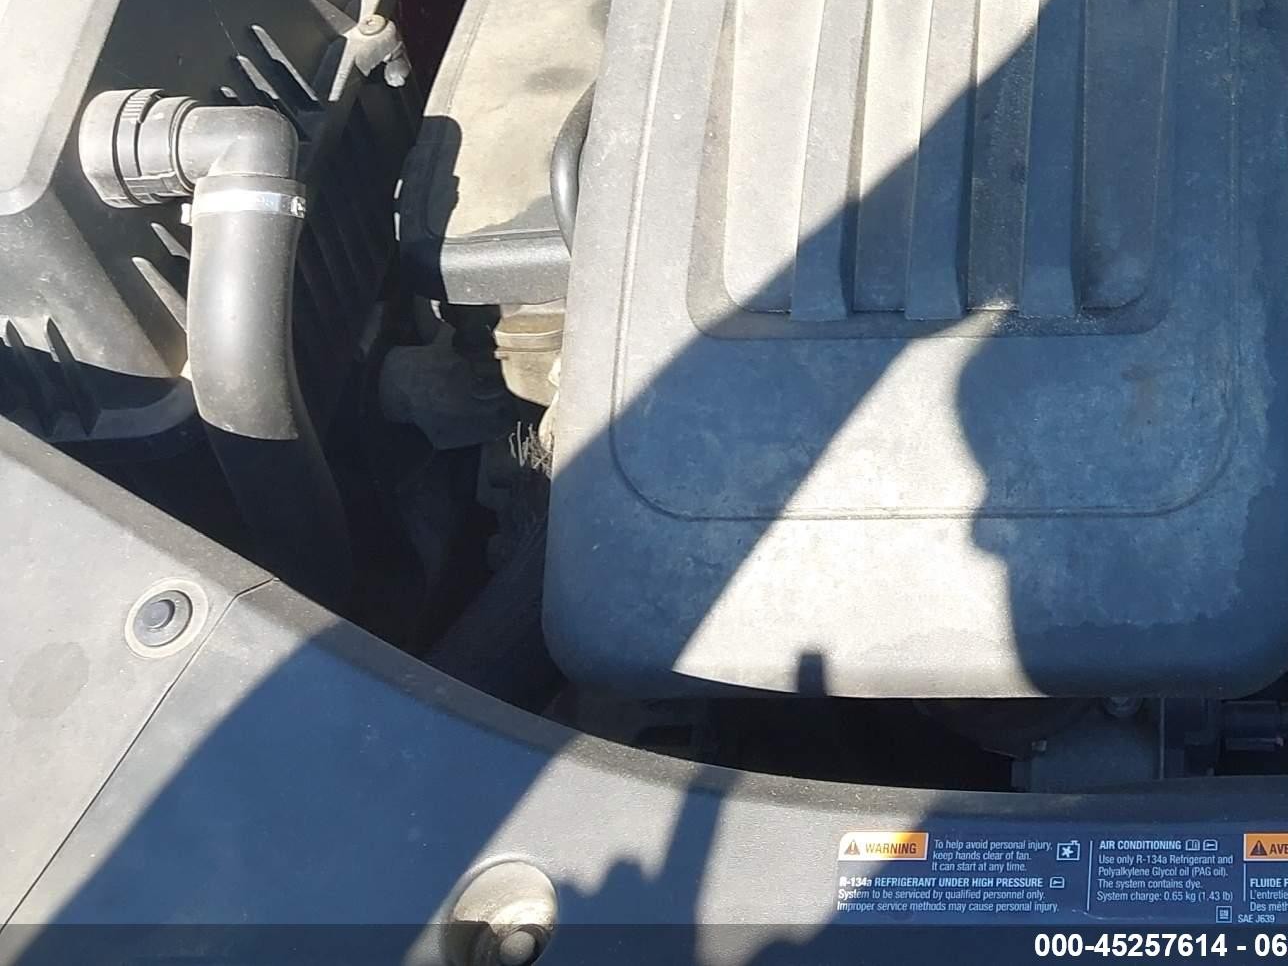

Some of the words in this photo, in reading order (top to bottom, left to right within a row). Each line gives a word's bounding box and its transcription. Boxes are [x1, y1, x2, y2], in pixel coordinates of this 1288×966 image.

[865, 843, 917, 854] WARNING
[933, 840, 943, 849] To
[945, 840, 963, 850] help
[965, 840, 988, 849] avoid
[990, 840, 1026, 850] personal
[1100, 840, 1115, 850] AIR
[1117, 840, 1181, 850] CONDITIONING
[932, 851, 953, 861] keep
[954, 851, 981, 860] hands
[982, 851, 1003, 860] clear
[1005, 851, 1015, 860] of
[1016, 851, 1032, 860] fan.
[1098, 854, 1114, 864] Use
[1116, 854, 1134, 865] only
[1136, 854, 1167, 864] R-134a
[1169, 854, 1215, 866] Refrigerant
[1217, 854, 1233, 864] and
[931, 862, 938, 871] It
[956, 862, 977, 871] start
[978, 862, 987, 871] at
[988, 864, 1004, 873] any
[1006, 862, 1027, 871] time.
[1098, 866, 1150, 878] Polyalkylene
[1151, 866, 1178, 878] Glycol
[1180, 866, 1189, 876] oil
[1191, 866, 1211, 877] (PAG
[1213, 866, 1229, 877] oil).
[839, 876, 872, 887] R-134a
[874, 876, 936, 887] REFRIGERANT
[939, 876, 970, 887] UNDER
[971, 876, 993, 887] HIGH
[995, 876, 1044, 887] PRESSURE
[1097, 878, 1113, 888] The
[1115, 878, 1145, 890] system
[1147, 878, 1183, 888] contains
[1185, 878, 1203, 890] dye.
[1250, 877, 1281, 887] FLUIDE
[838, 889, 870, 901] System
[872, 890, 880, 899] to
[882, 890, 893, 899] be
[895, 890, 930, 899] serviced
[932, 890, 943, 900] by
[945, 890, 981, 900] qualified
[983, 890, 1025, 901] personnel
[1026, 890, 1046, 901] only.
[1097, 891, 1128, 902] System
[1130, 891, 1162, 902] charge:
[1163, 891, 1183, 901] 0.65
[1185, 891, 1196, 902] kg
[1198, 891, 1220, 902] (1.43
[1222, 891, 1233, 902] lb)
[837, 902, 874, 913] Improper
[877, 902, 908, 911] service
[909, 902, 946, 911] methods
[948, 903, 966, 913] may
[968, 903, 994, 912] cause
[996, 902, 1032, 913] personal
[1034, 902, 1060, 913] injury.
[1250, 902, 1266, 912] Des
[1237, 914, 1253, 923] SAE
[1255, 914, 1275, 923] J639
